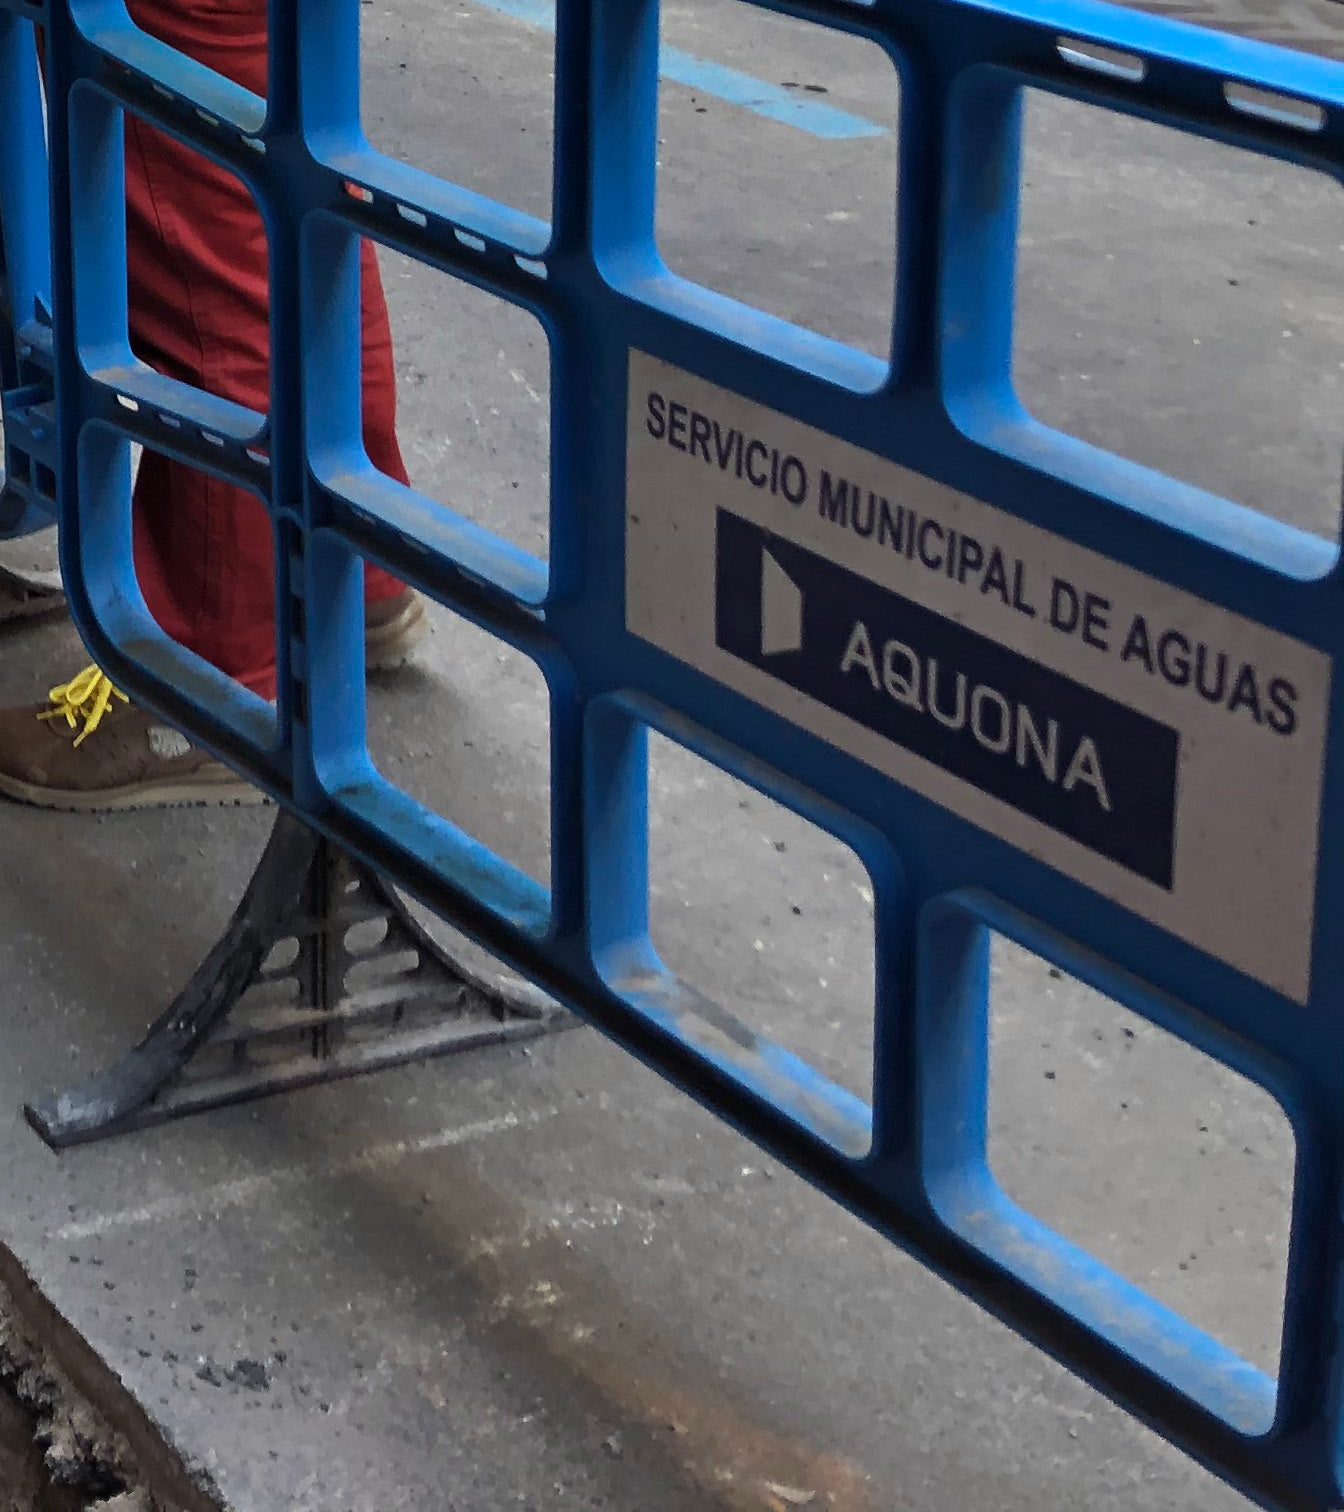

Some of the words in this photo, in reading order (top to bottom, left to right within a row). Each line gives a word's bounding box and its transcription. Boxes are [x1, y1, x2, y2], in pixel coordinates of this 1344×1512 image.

[646, 391, 809, 506] SERVICIO
[818, 468, 1035, 617] MUNICIPAL
[1050, 575, 1112, 652] DE
[1120, 613, 1300, 737] AGUAS
[839, 620, 1112, 813] AQUONA
